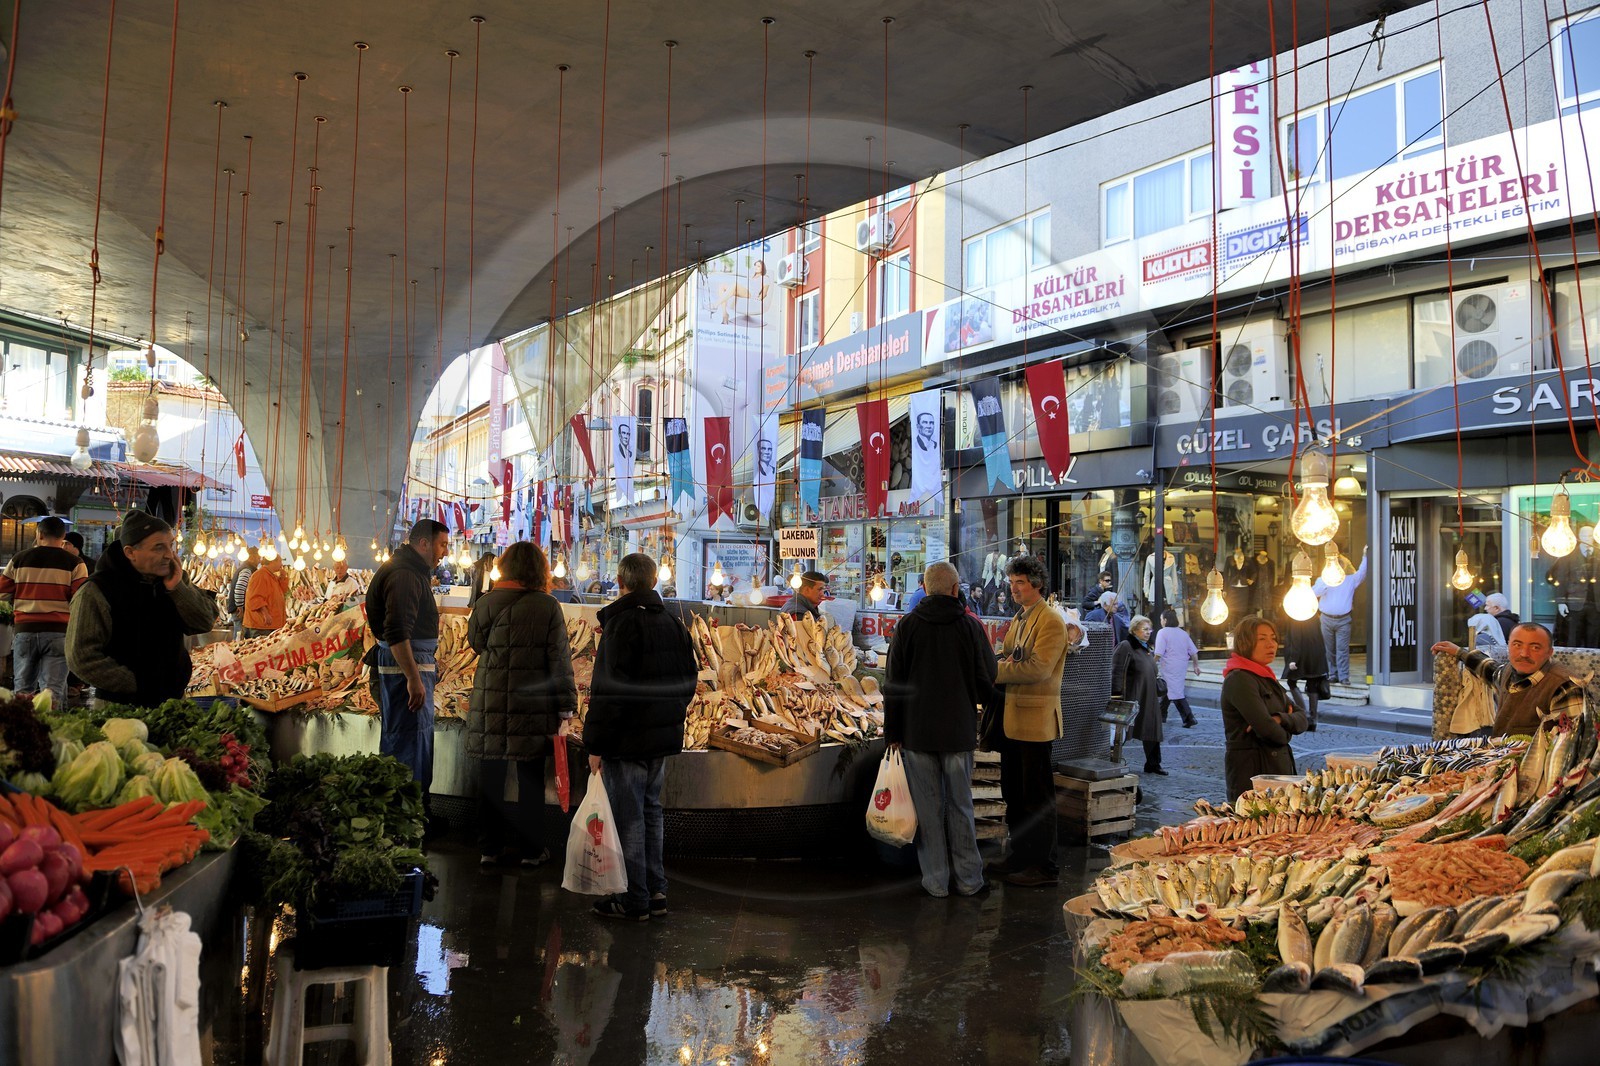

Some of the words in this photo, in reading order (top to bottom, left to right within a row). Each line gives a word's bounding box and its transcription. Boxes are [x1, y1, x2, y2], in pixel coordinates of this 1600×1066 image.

[1375, 154, 1505, 206] KÜLTÜR
[1334, 162, 1559, 242] DERSANELERİ
[1334, 230, 1419, 257] BİLGİSAYAR
[1421, 209, 1499, 238] DESTEKLİ
[1501, 198, 1561, 220] EĞİTİM
[1012, 274, 1125, 325] DERSANELERİ
[1033, 265, 1098, 300] KÜLTÜR
[836, 329, 910, 375] Dershaneleri
[1492, 378, 1600, 416] SAR
[1176, 426, 1251, 456] GÜZEL
[1261, 418, 1342, 453] ÇARŞI
[1346, 434, 1362, 448] 45
[781, 530, 815, 540] LAKERDA
[781, 547, 816, 558] BULUNUR
[1389, 607, 1406, 648] 49
